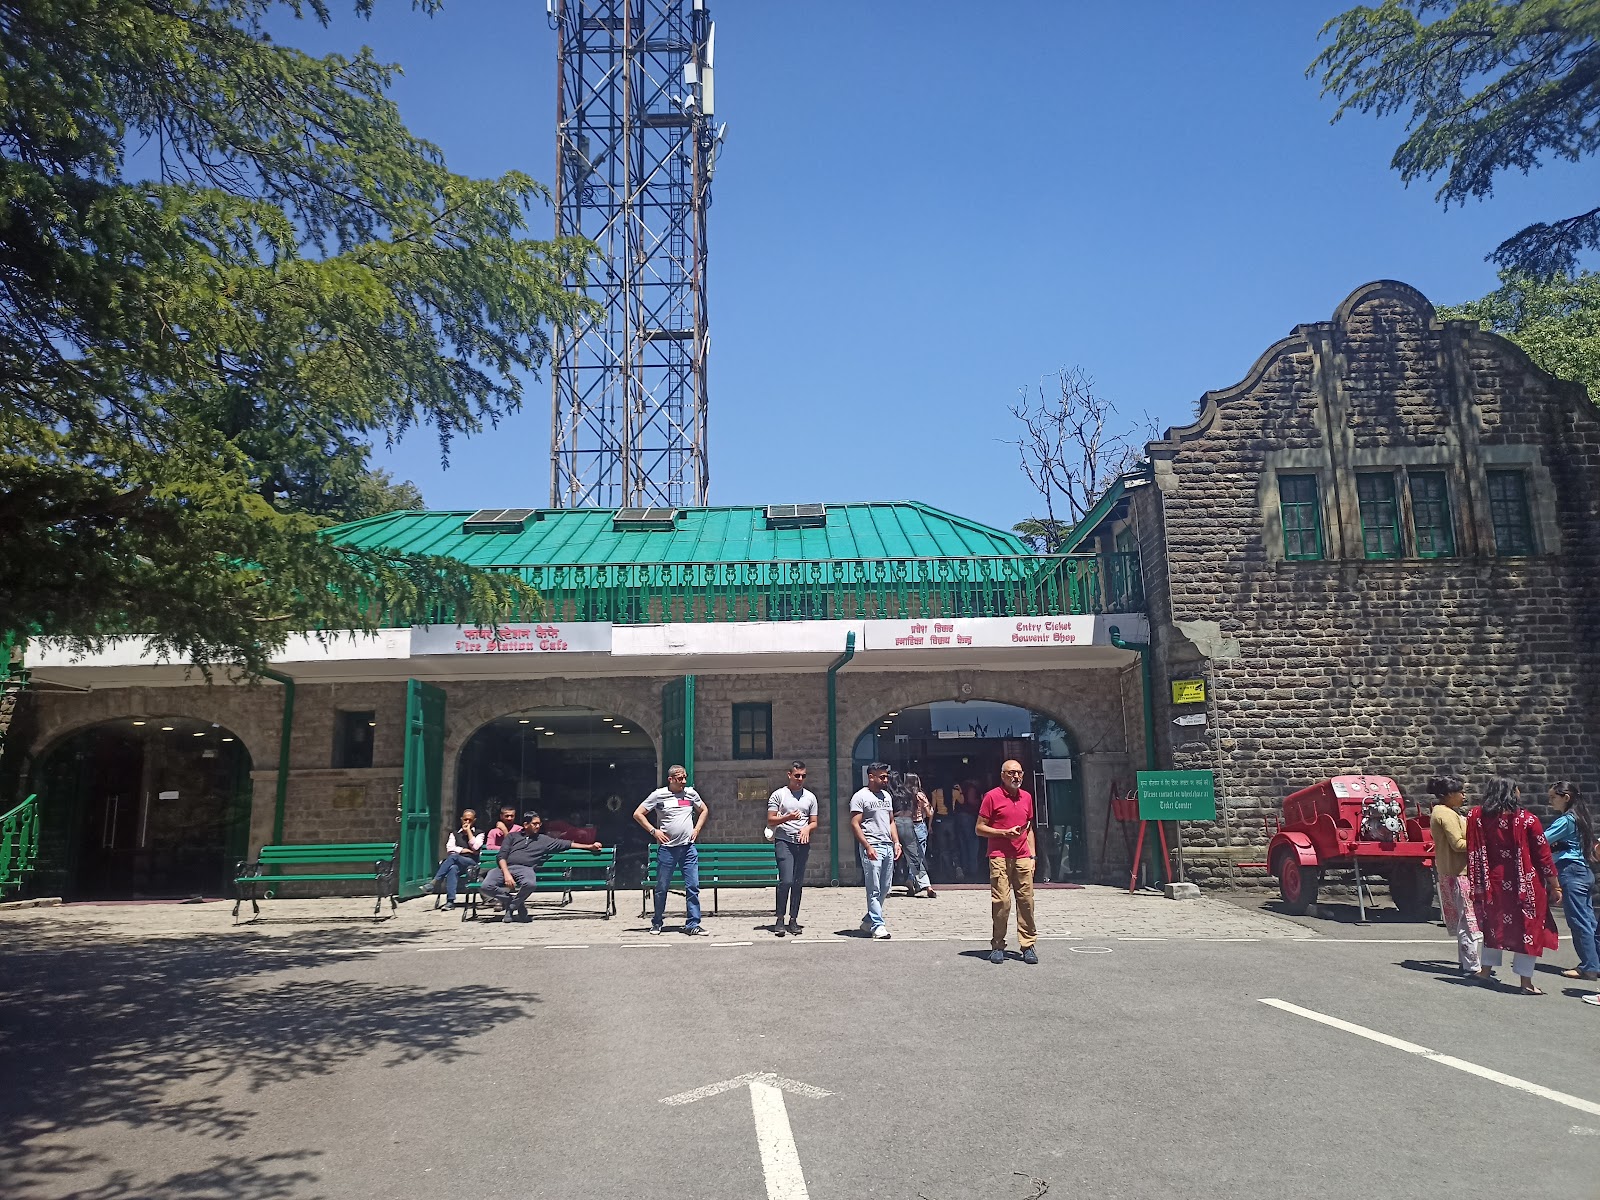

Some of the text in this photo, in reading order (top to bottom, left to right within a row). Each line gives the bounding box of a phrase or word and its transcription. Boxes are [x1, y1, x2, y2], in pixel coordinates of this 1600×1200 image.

[1016, 621, 1072, 632] Entry Ticket
[1011, 632, 1076, 643] Souvenir Shop
[455, 640, 481, 652] Fire
[540, 639, 568, 651] Cafe
[1159, 800, 1192, 810] Ticket Counter
